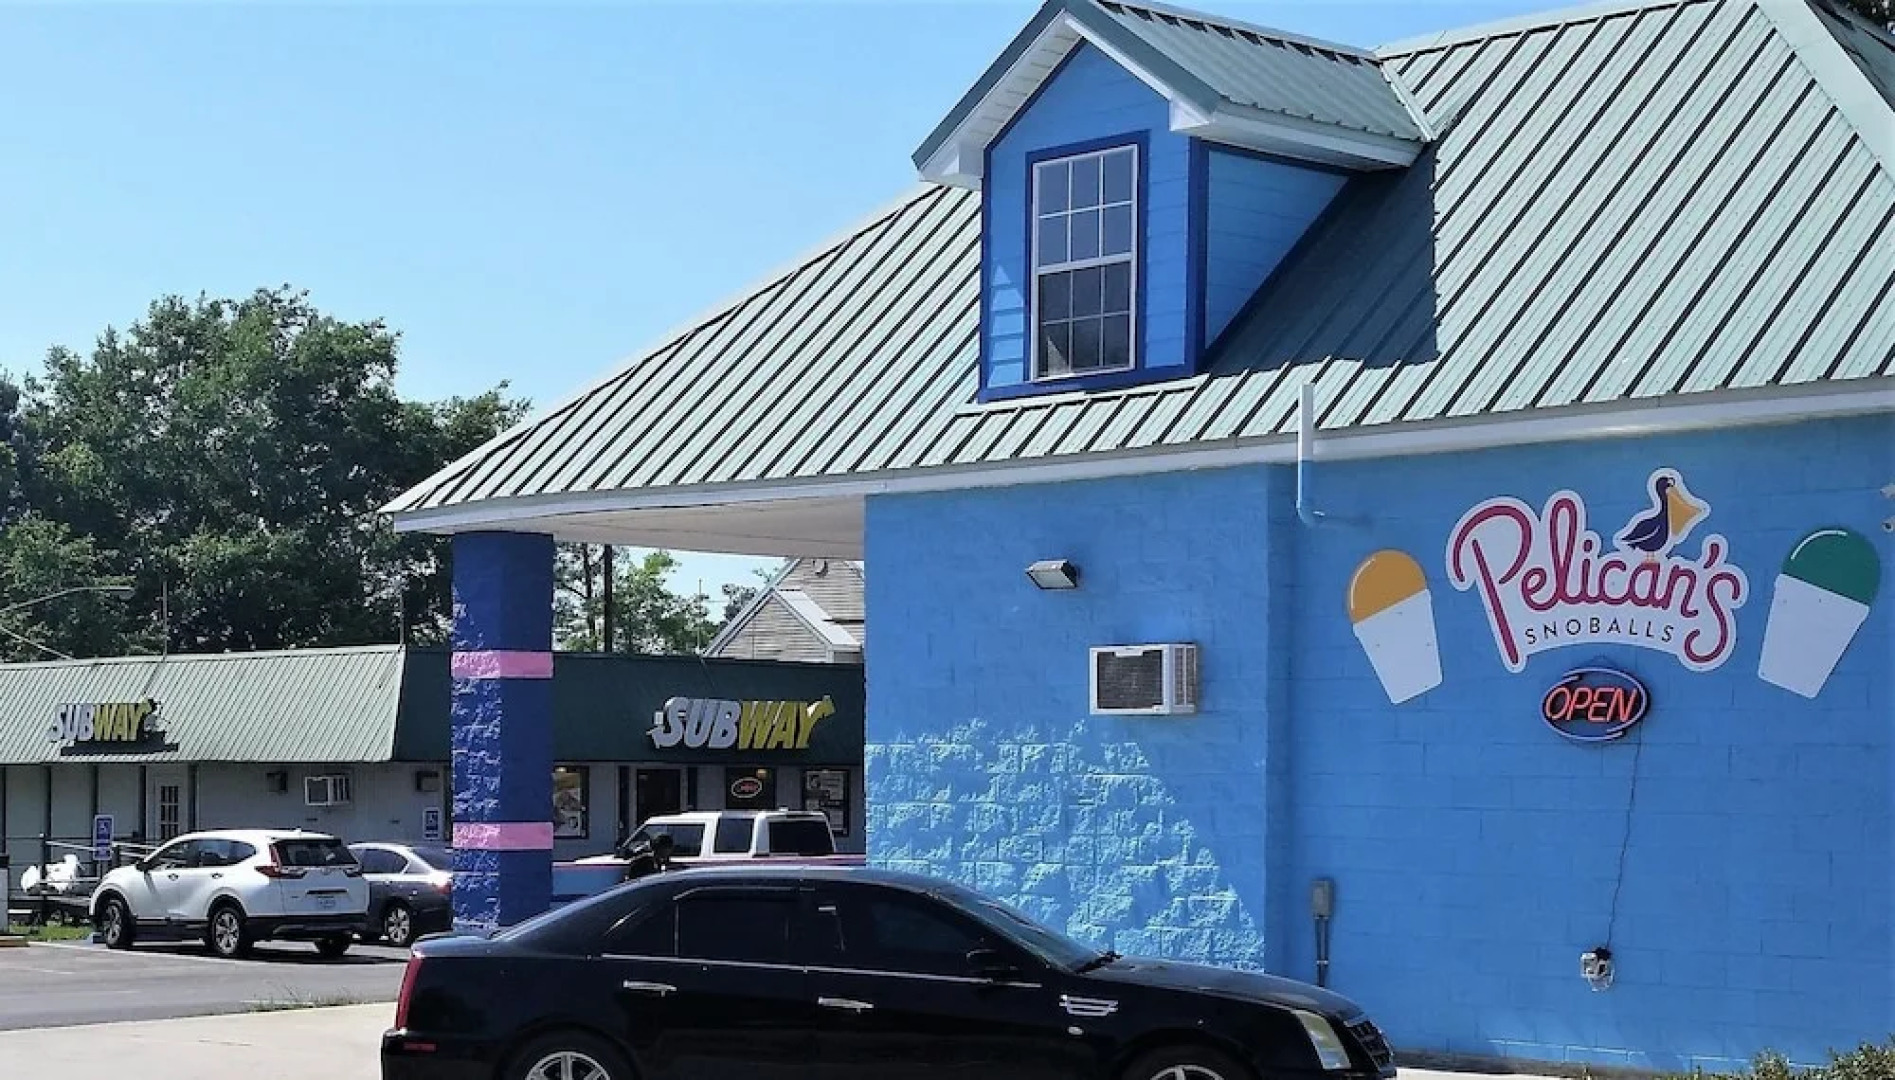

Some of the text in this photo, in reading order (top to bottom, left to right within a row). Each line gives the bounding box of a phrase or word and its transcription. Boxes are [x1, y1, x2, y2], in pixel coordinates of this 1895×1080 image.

[1452, 497, 1742, 665] Pelican's
[1524, 616, 1676, 646] SNOBALLS
[46, 697, 152, 741] SUBWAY
[647, 695, 835, 750] SUBWAY
[1544, 685, 1639, 724] OPEN
